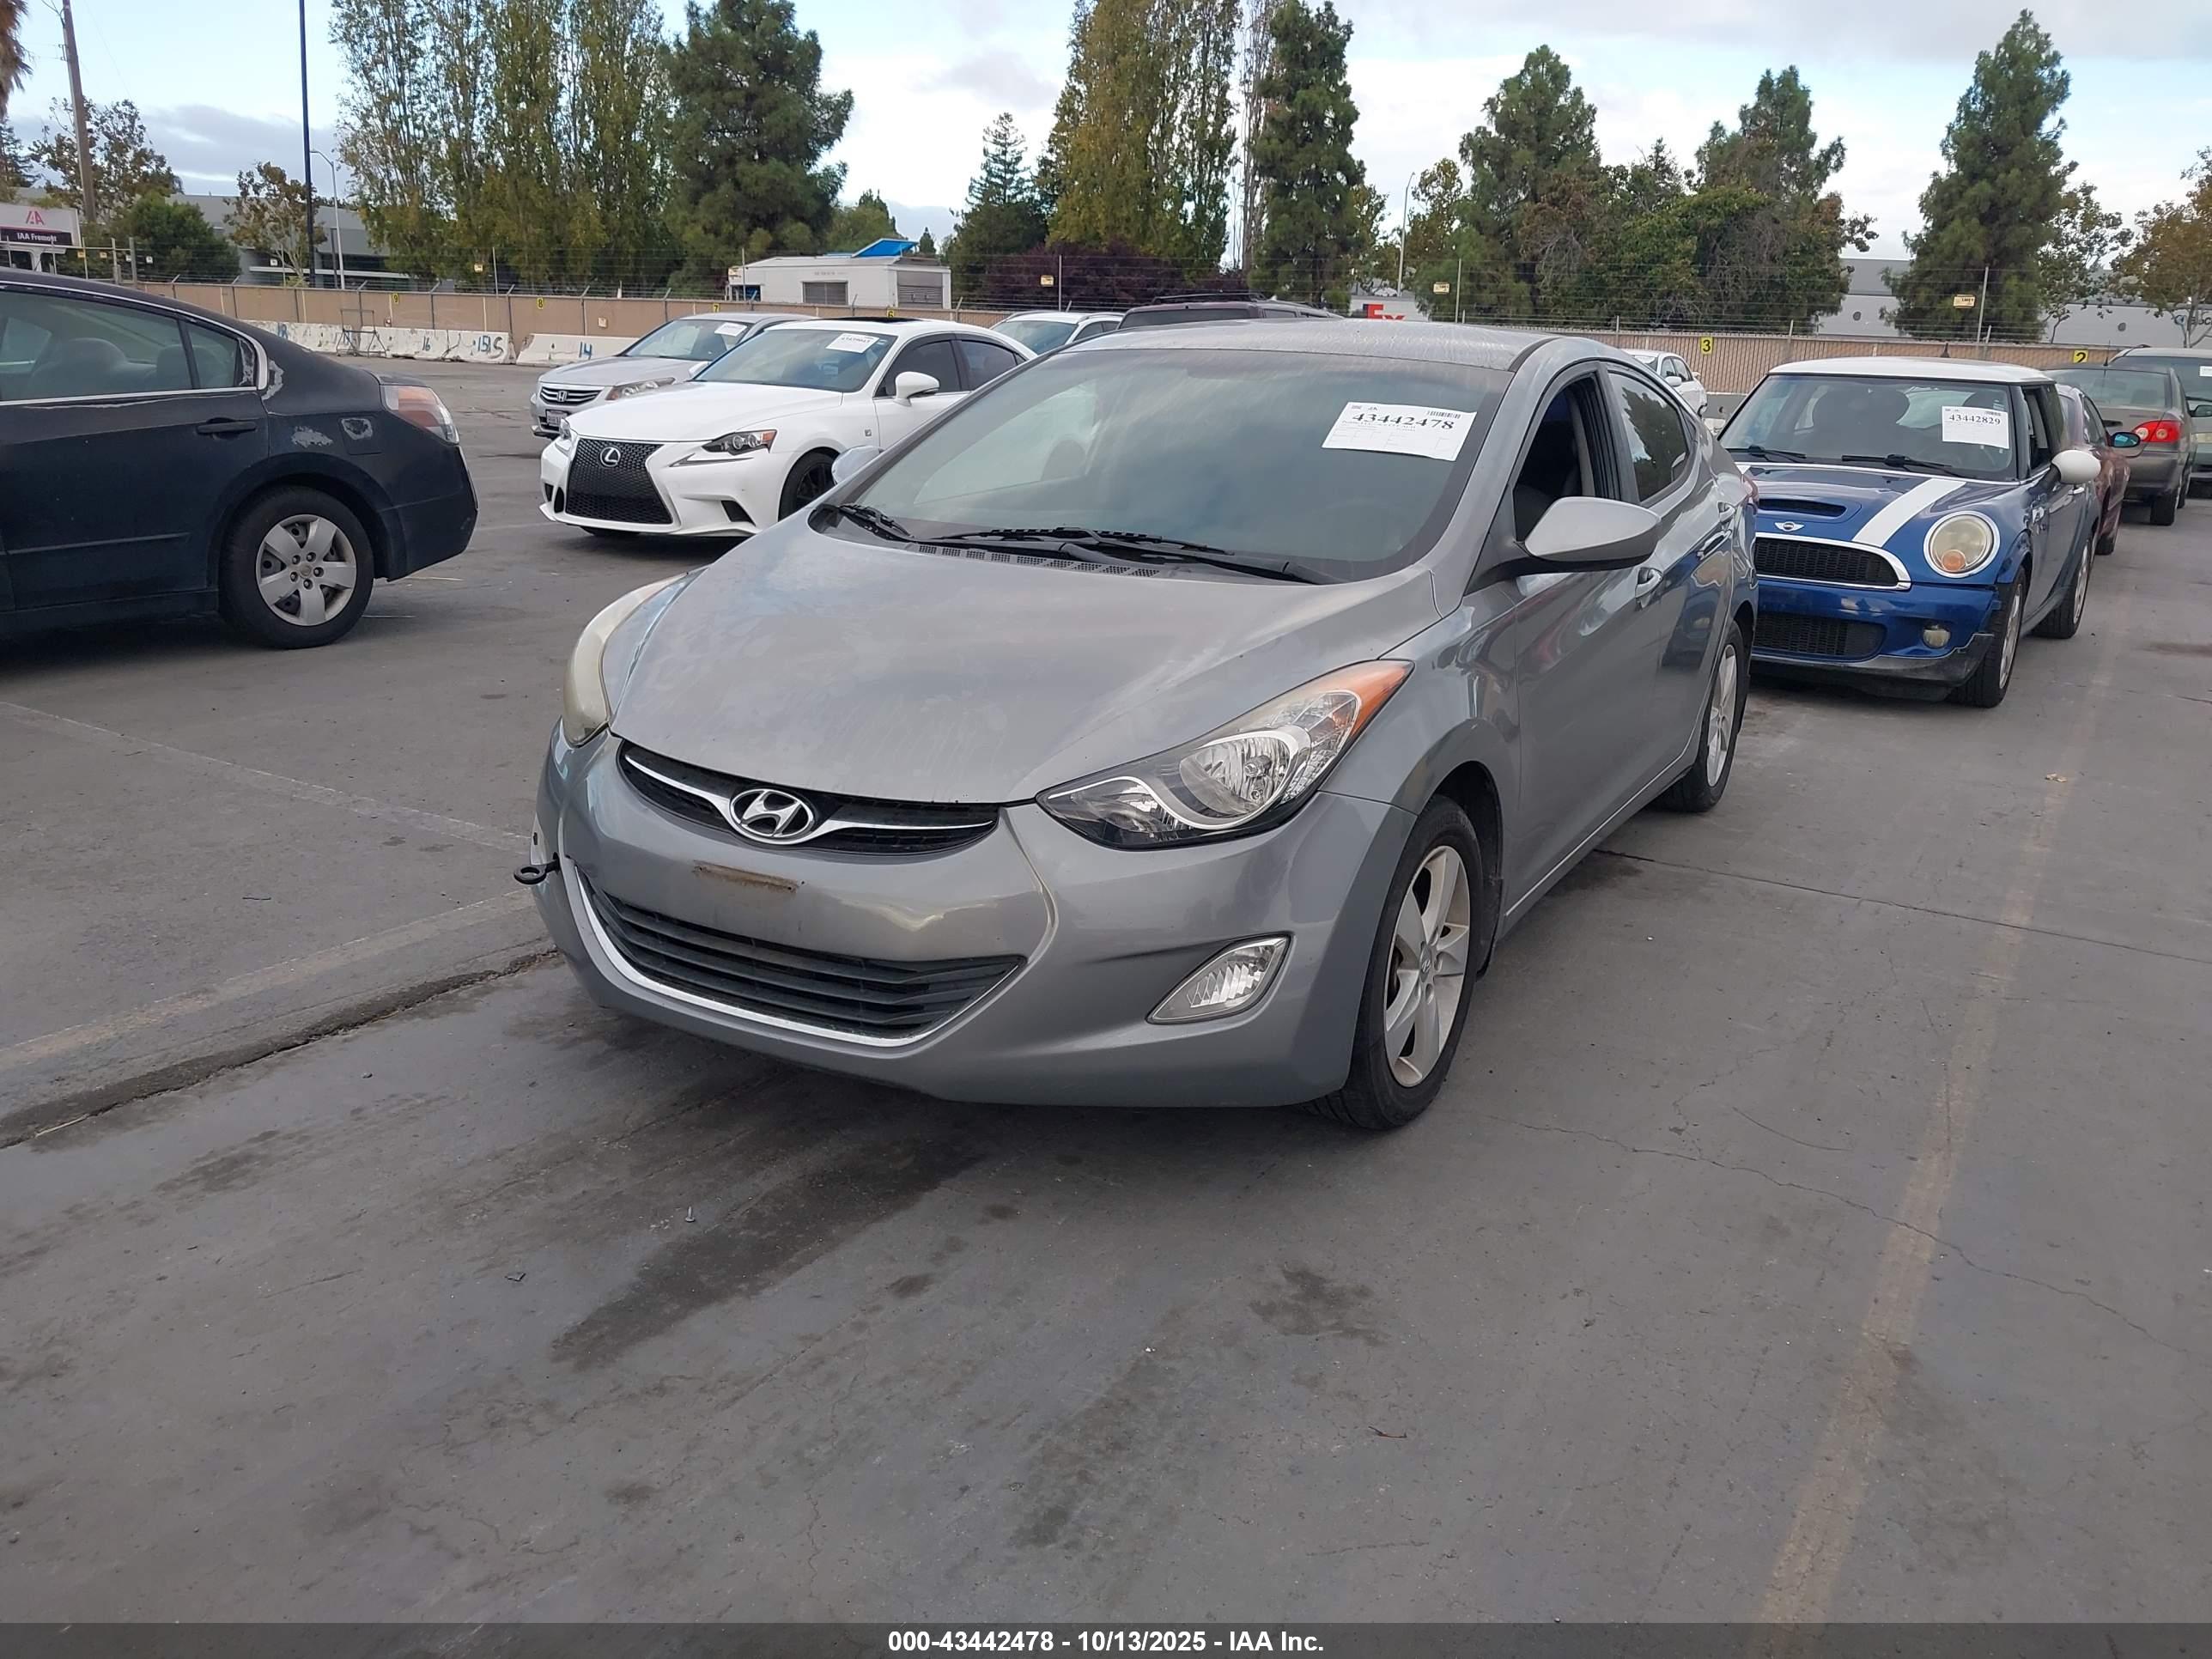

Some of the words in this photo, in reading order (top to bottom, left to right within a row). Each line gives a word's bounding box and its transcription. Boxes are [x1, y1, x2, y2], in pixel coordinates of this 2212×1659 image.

[17, 232, 30, 240] IAA
[579, 341, 592, 361] 14
[1702, 339, 1711, 352] 3
[2076, 351, 2087, 363] 2
[1352, 412, 1455, 430] 43442478
[1948, 414, 2001, 425] 43442829
